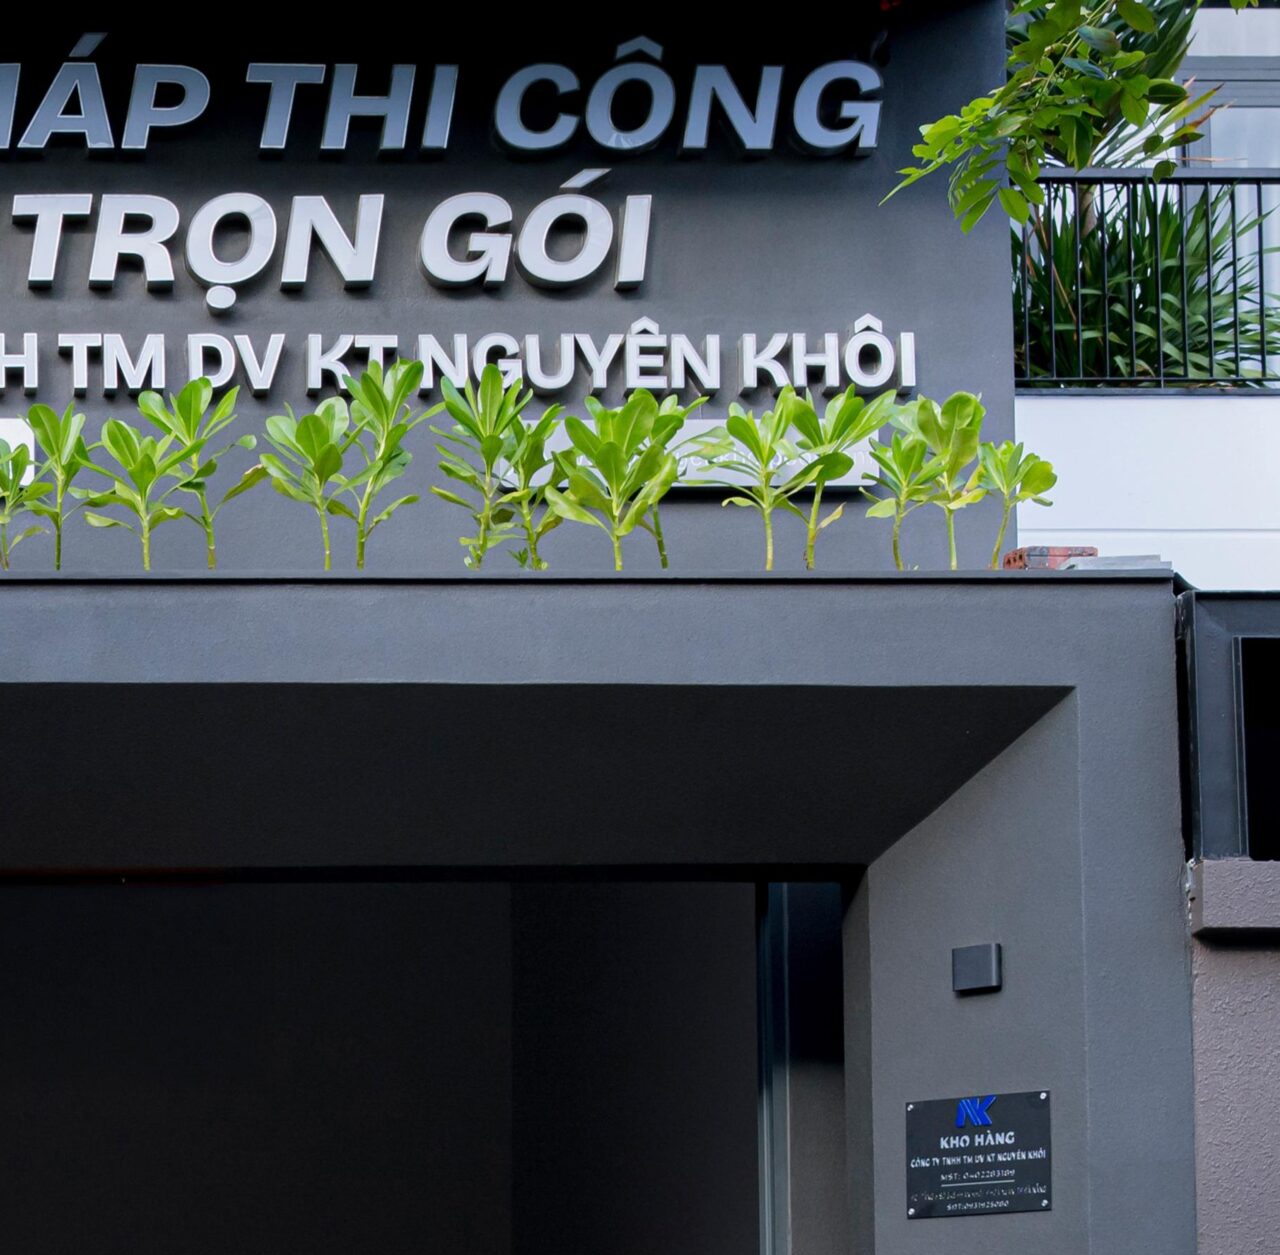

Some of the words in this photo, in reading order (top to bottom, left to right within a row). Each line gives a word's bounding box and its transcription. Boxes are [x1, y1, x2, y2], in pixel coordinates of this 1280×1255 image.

[246, 62, 459, 153] THI
[494, 35, 884, 155] CÔNG
[11, 191, 384, 313] TRỌN
[420, 167, 652, 290] GÓI
[58, 332, 166, 395] TM
[187, 333, 286, 397] DV
[306, 333, 399, 396] KT
[418, 315, 721, 395] NGUYÊN
[740, 313, 917, 395] KHÔI
[940, 1135, 970, 1149] KHO
[975, 1130, 1015, 1147] HÀNG
